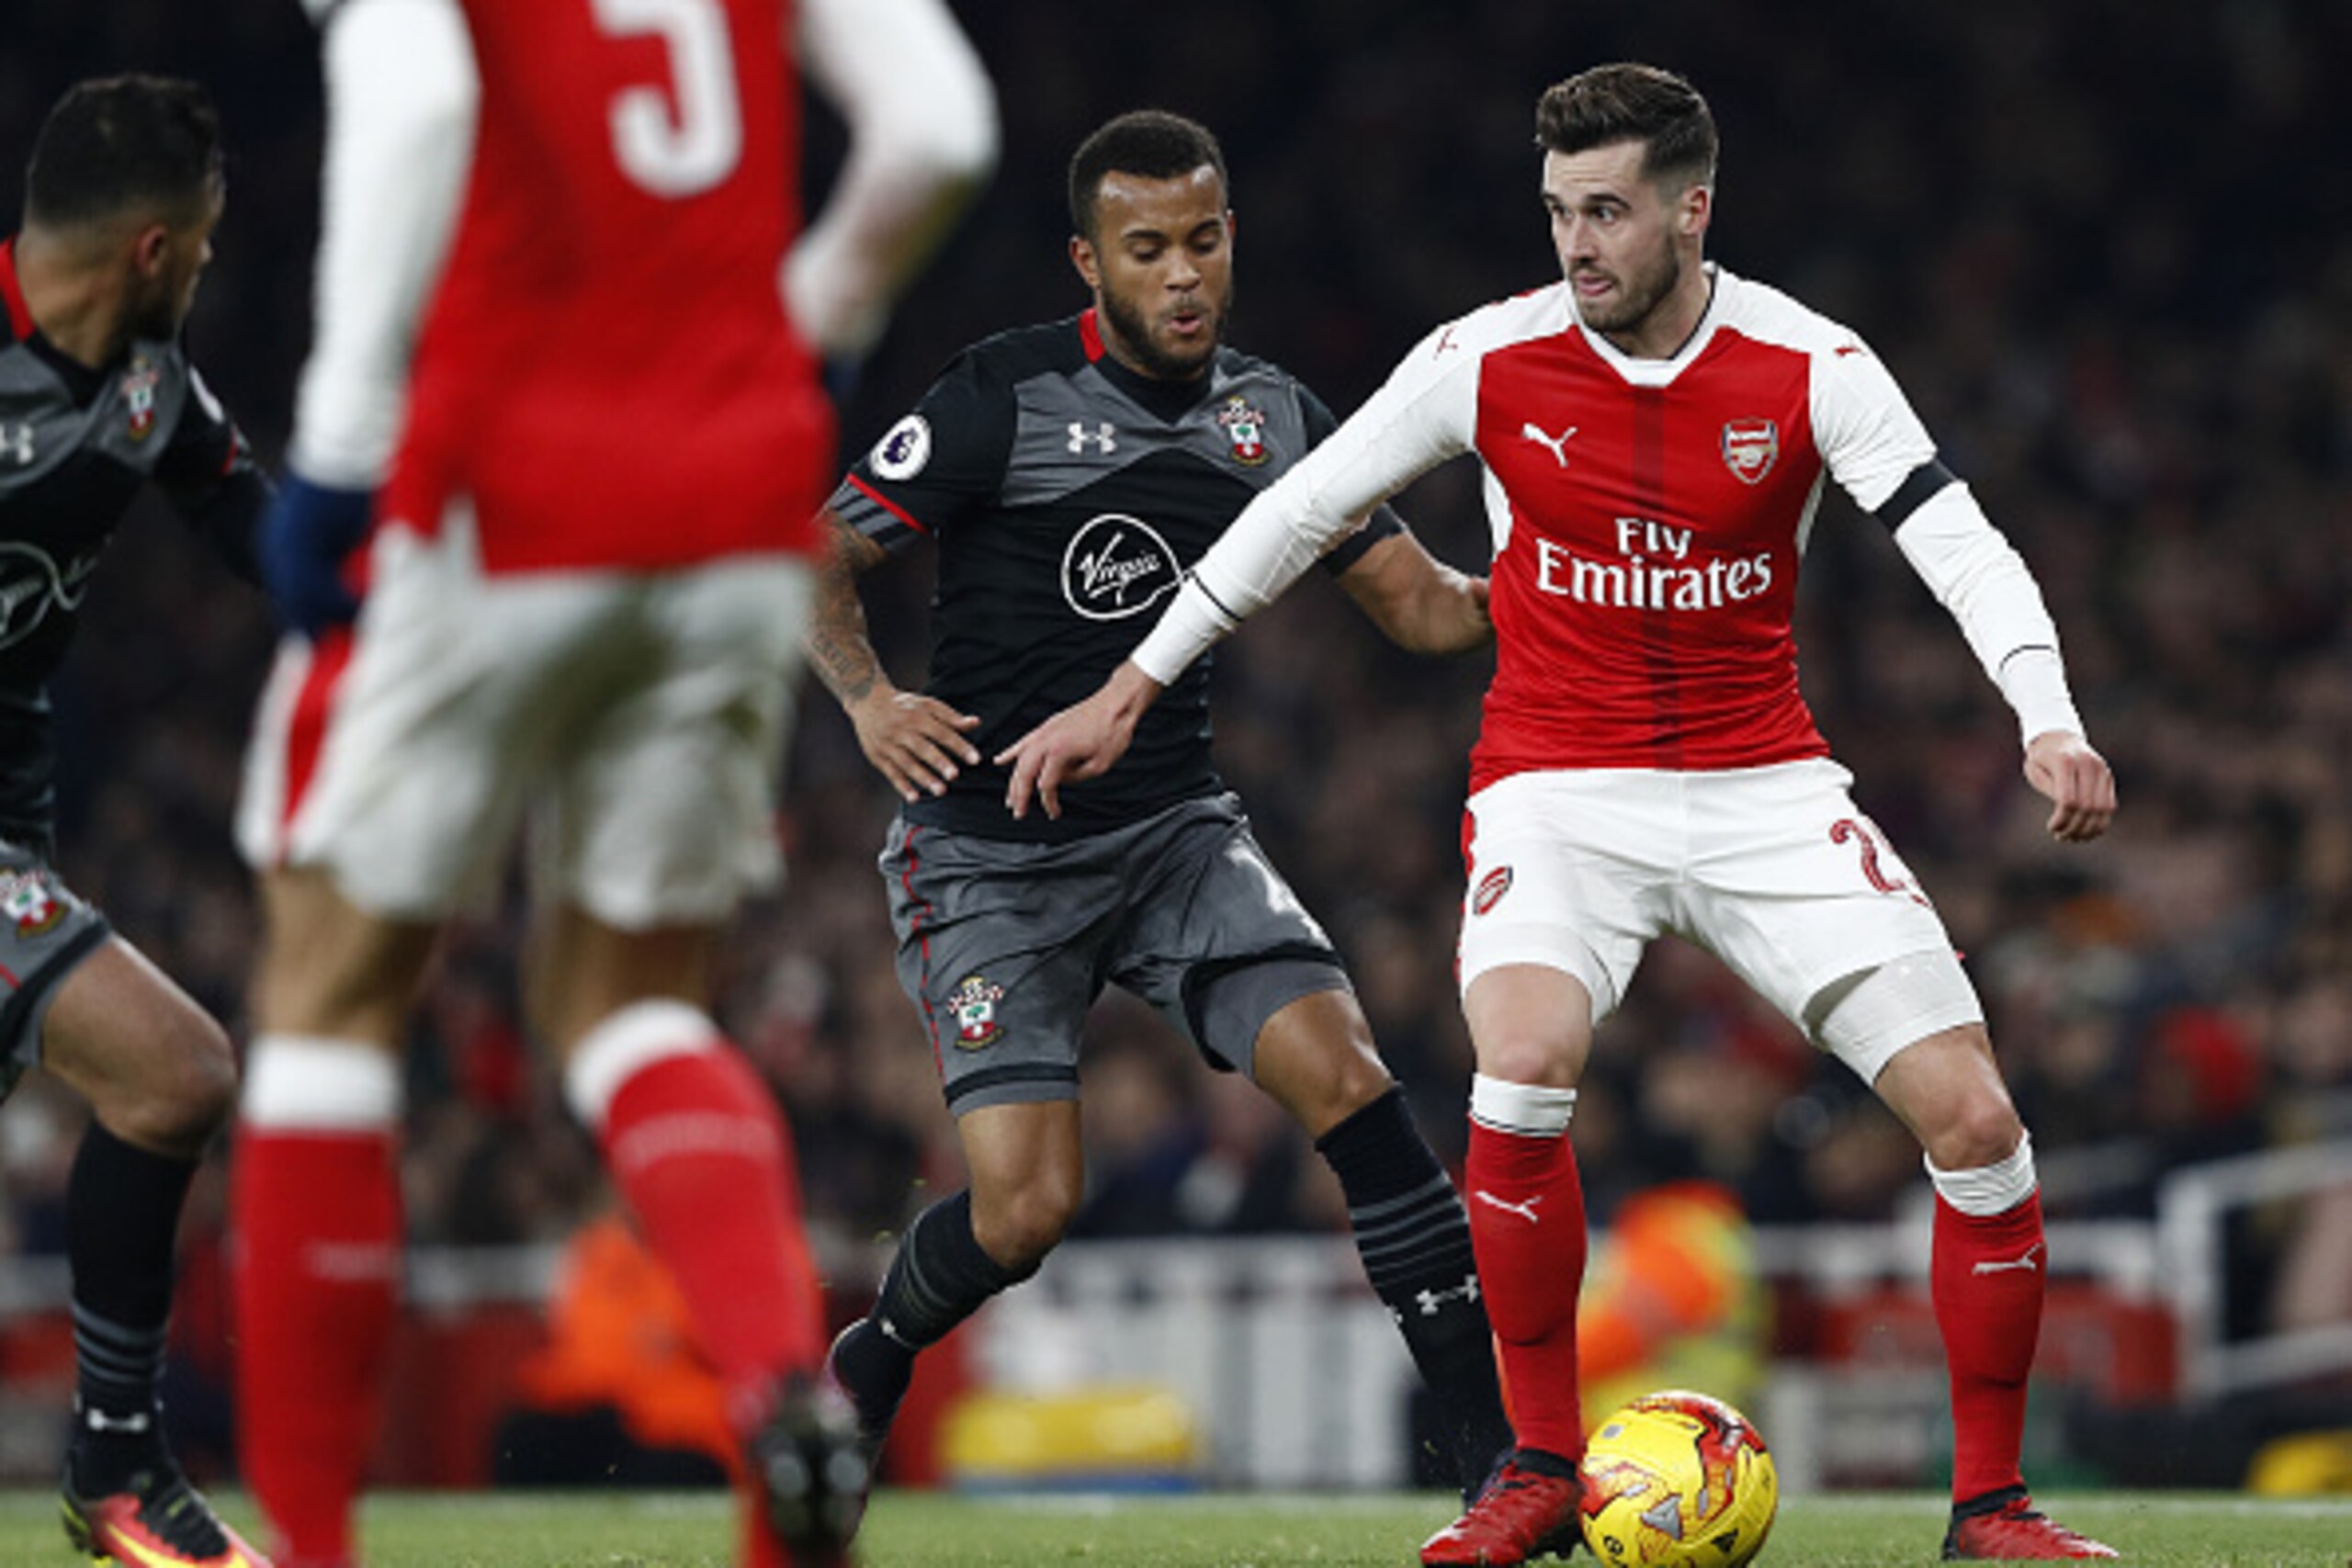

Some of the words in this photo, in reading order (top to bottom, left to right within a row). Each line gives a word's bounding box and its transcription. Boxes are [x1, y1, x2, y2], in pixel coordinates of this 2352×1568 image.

[1077, 530, 1162, 606] Virgin
[1535, 537, 1771, 611] Emirates
[1615, 518, 1691, 559] Fly
[1829, 817, 1931, 908] 2
